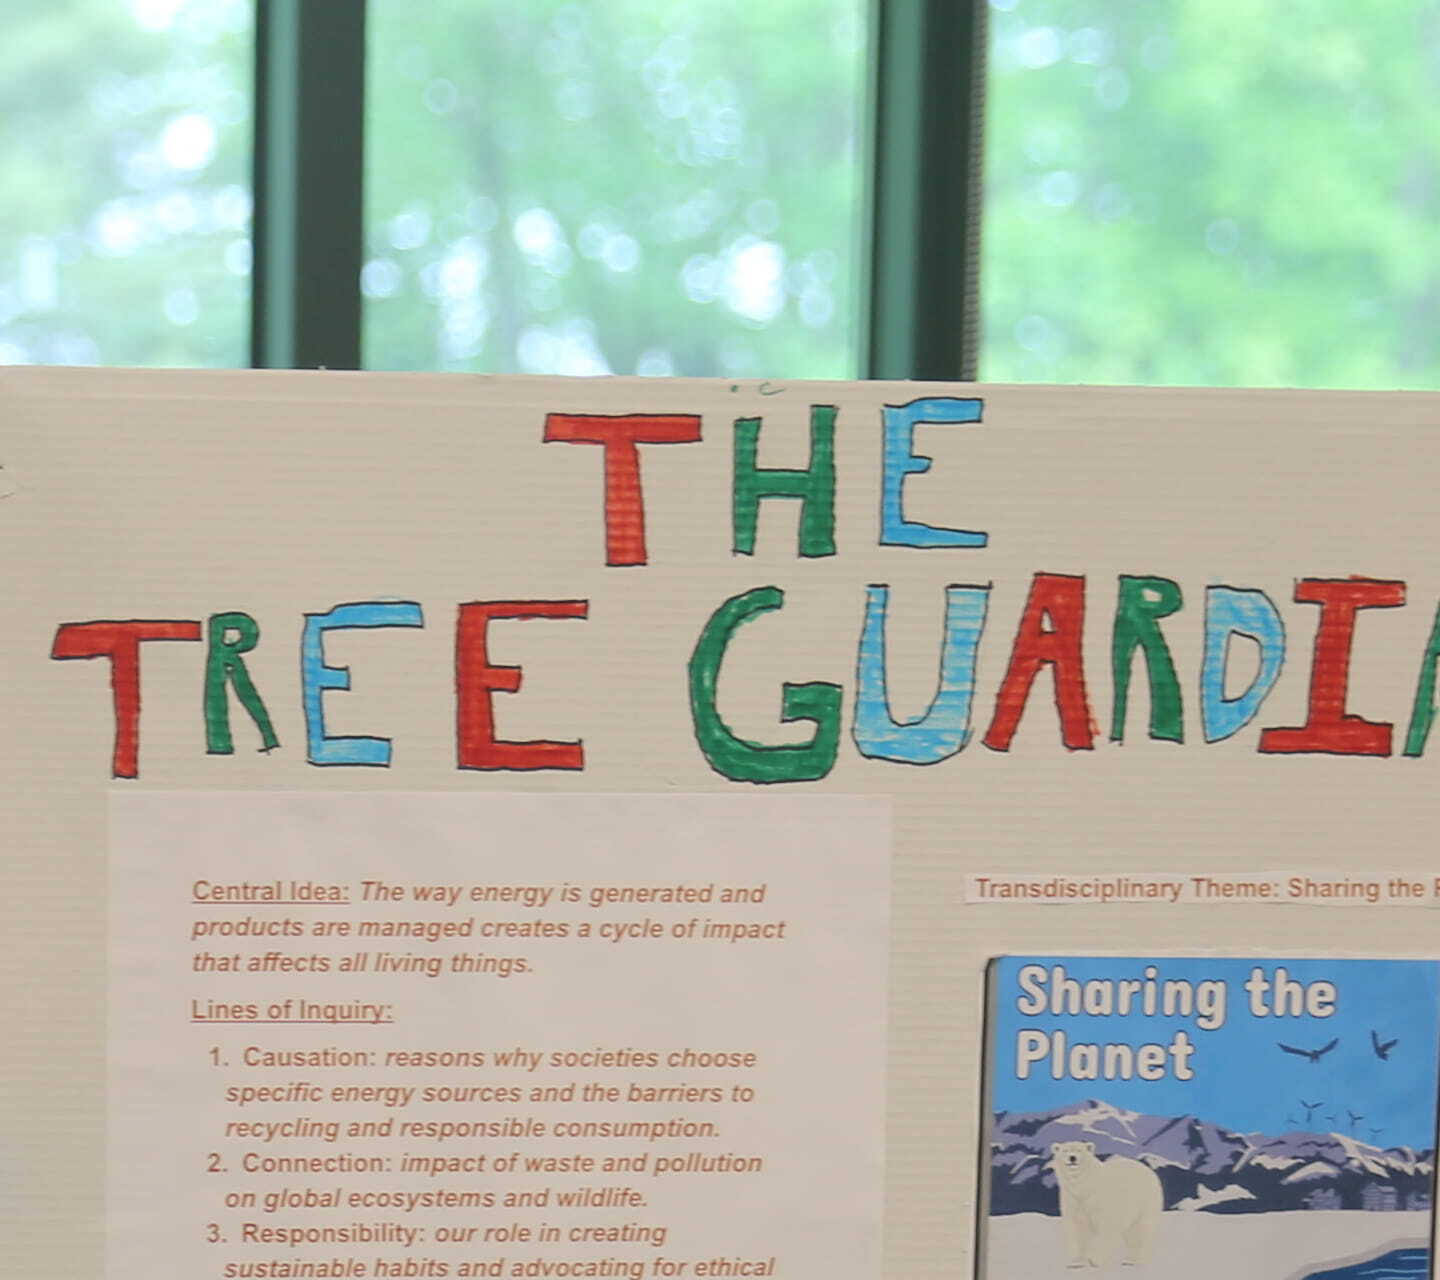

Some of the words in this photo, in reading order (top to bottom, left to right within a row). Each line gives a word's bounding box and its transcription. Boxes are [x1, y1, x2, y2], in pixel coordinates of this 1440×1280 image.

[543, 398, 987, 566] THE
[49, 597, 589, 778] TREE
[192, 879, 282, 901] Central
[290, 881, 349, 901] Idea:
[360, 880, 405, 902] The
[412, 886, 463, 907] way
[469, 886, 555, 908] energy
[560, 882, 583, 903] is
[588, 883, 714, 908] generated
[720, 883, 767, 904] and
[975, 877, 1183, 903] Transdisciplinary
[1190, 877, 1279, 898] Theme:
[1288, 877, 1380, 903] Sharing
[1388, 878, 1425, 898] the
[191, 916, 304, 941] products
[312, 921, 351, 937] are
[357, 917, 475, 943] managed
[480, 919, 570, 938] creates
[577, 922, 591, 938] a
[599, 918, 664, 944] cycle
[671, 917, 699, 939] of
[702, 918, 787, 944] impact
[192, 951, 241, 972] that
[247, 951, 331, 973] affects
[338, 952, 368, 973] all
[374, 952, 443, 978] living
[451, 952, 533, 979] things.
[1017, 964, 1226, 1031] Sharing
[1244, 967, 1337, 1018] the
[192, 999, 259, 1020] Lines
[267, 999, 293, 1020] of
[300, 999, 392, 1025] Inquiry:
[209, 1046, 229, 1067] 1.
[243, 1046, 376, 1067] Causation:
[384, 1051, 485, 1068] reasons
[493, 1047, 544, 1073] why
[549, 1047, 659, 1068] societies
[667, 1047, 757, 1068] choose
[1016, 1029, 1195, 1081] Planet
